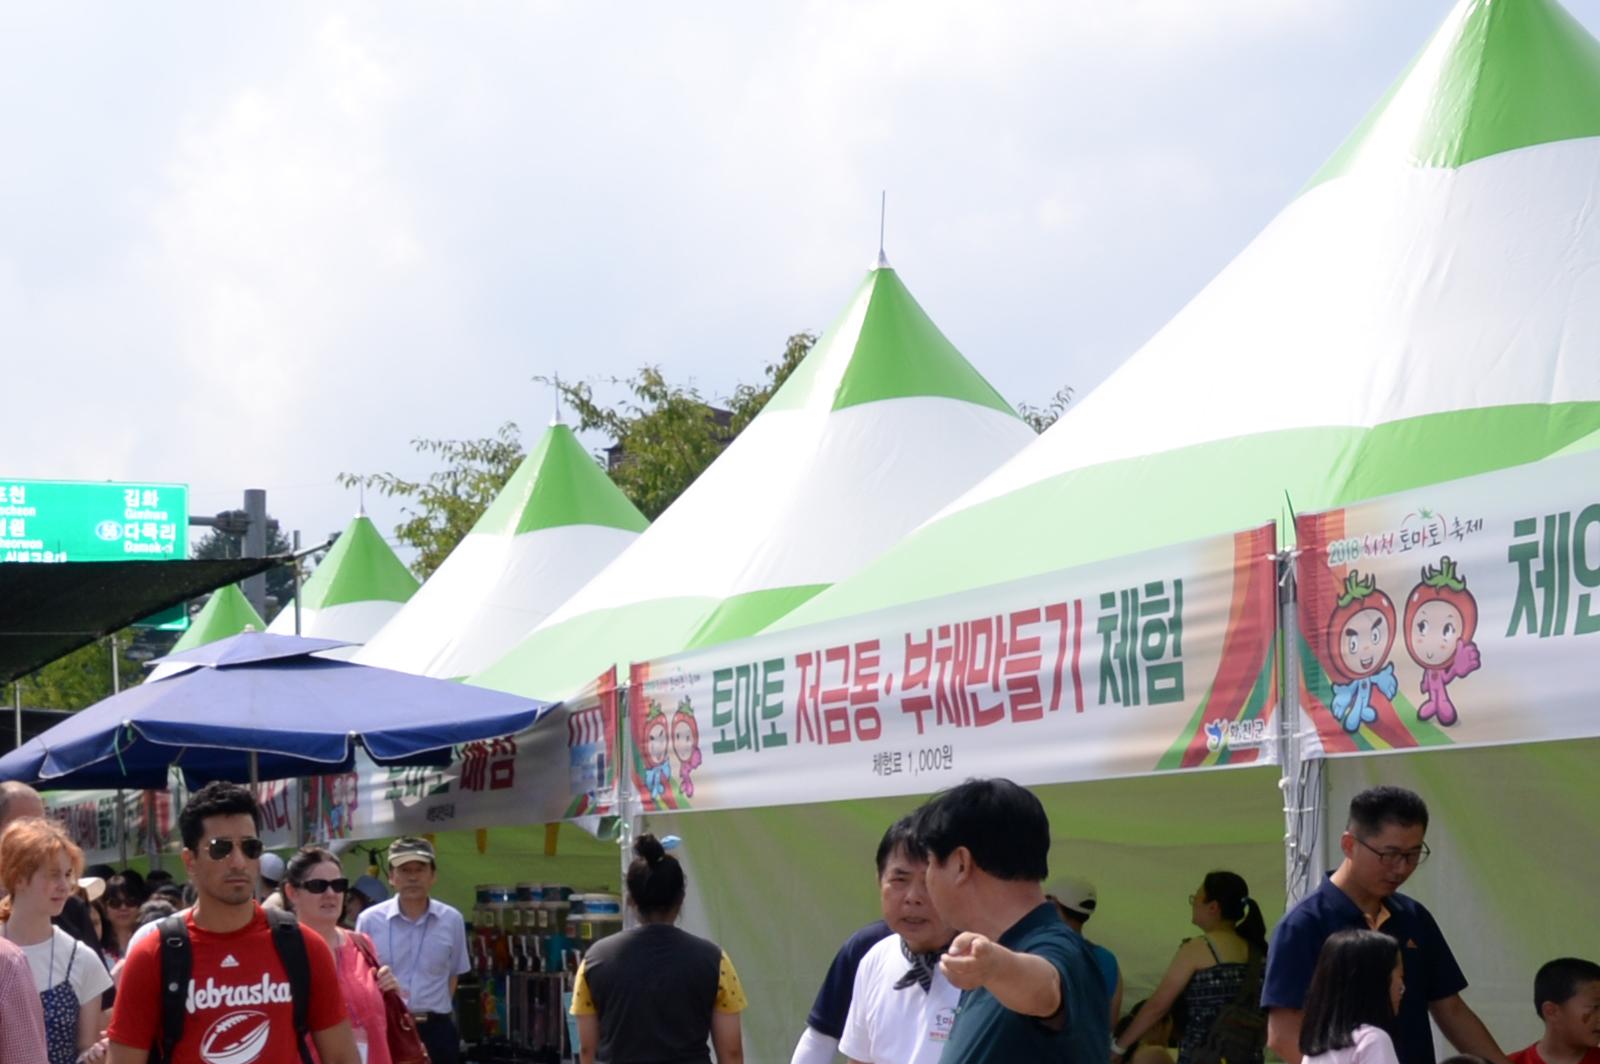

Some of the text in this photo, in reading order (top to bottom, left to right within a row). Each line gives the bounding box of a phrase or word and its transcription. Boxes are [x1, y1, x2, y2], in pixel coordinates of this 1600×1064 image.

[124, 489, 159, 508] 김화
[124, 522, 176, 541] 다목리
[1329, 541, 1360, 564] 2018
[1399, 523, 1442, 553] 토마토
[1449, 515, 1483, 543] 축제
[711, 657, 789, 755] 토마토
[1097, 577, 1185, 708] 체험
[872, 744, 953, 777] 체험료 1,000원
